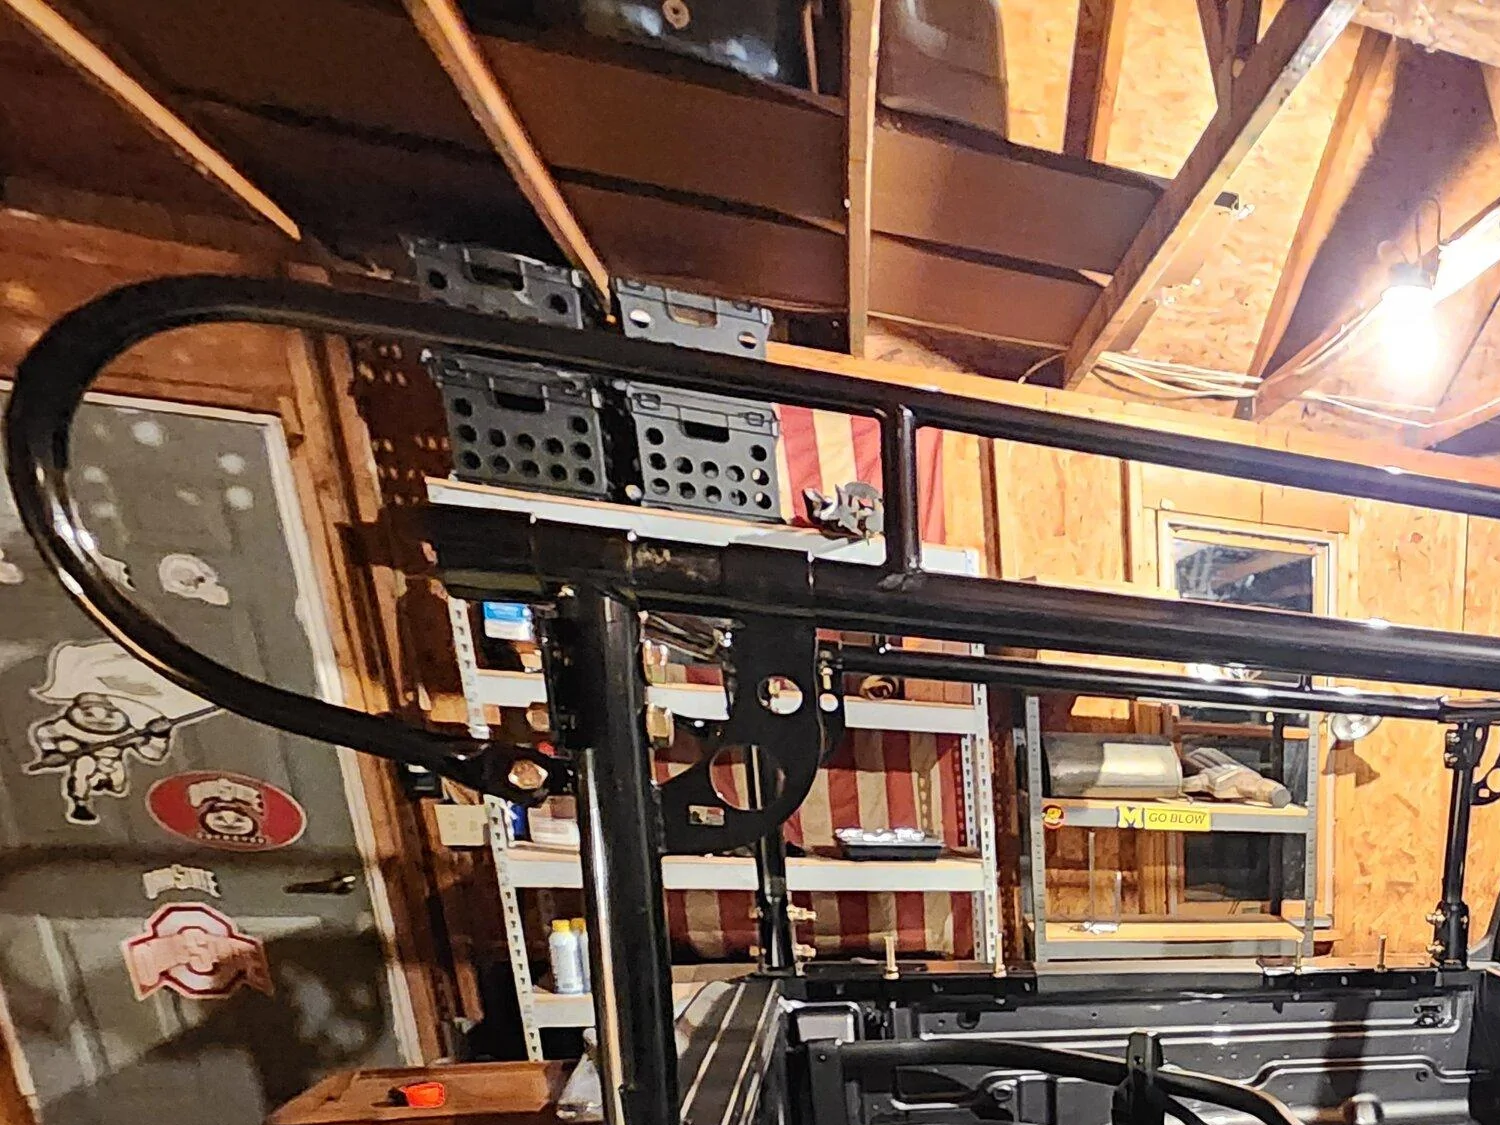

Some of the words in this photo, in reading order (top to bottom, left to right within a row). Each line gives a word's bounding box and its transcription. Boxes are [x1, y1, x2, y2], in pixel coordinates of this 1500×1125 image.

[1117, 806, 1144, 829] M
[1148, 812, 1167, 823] GO
[1170, 814, 1205, 825] BLOW
